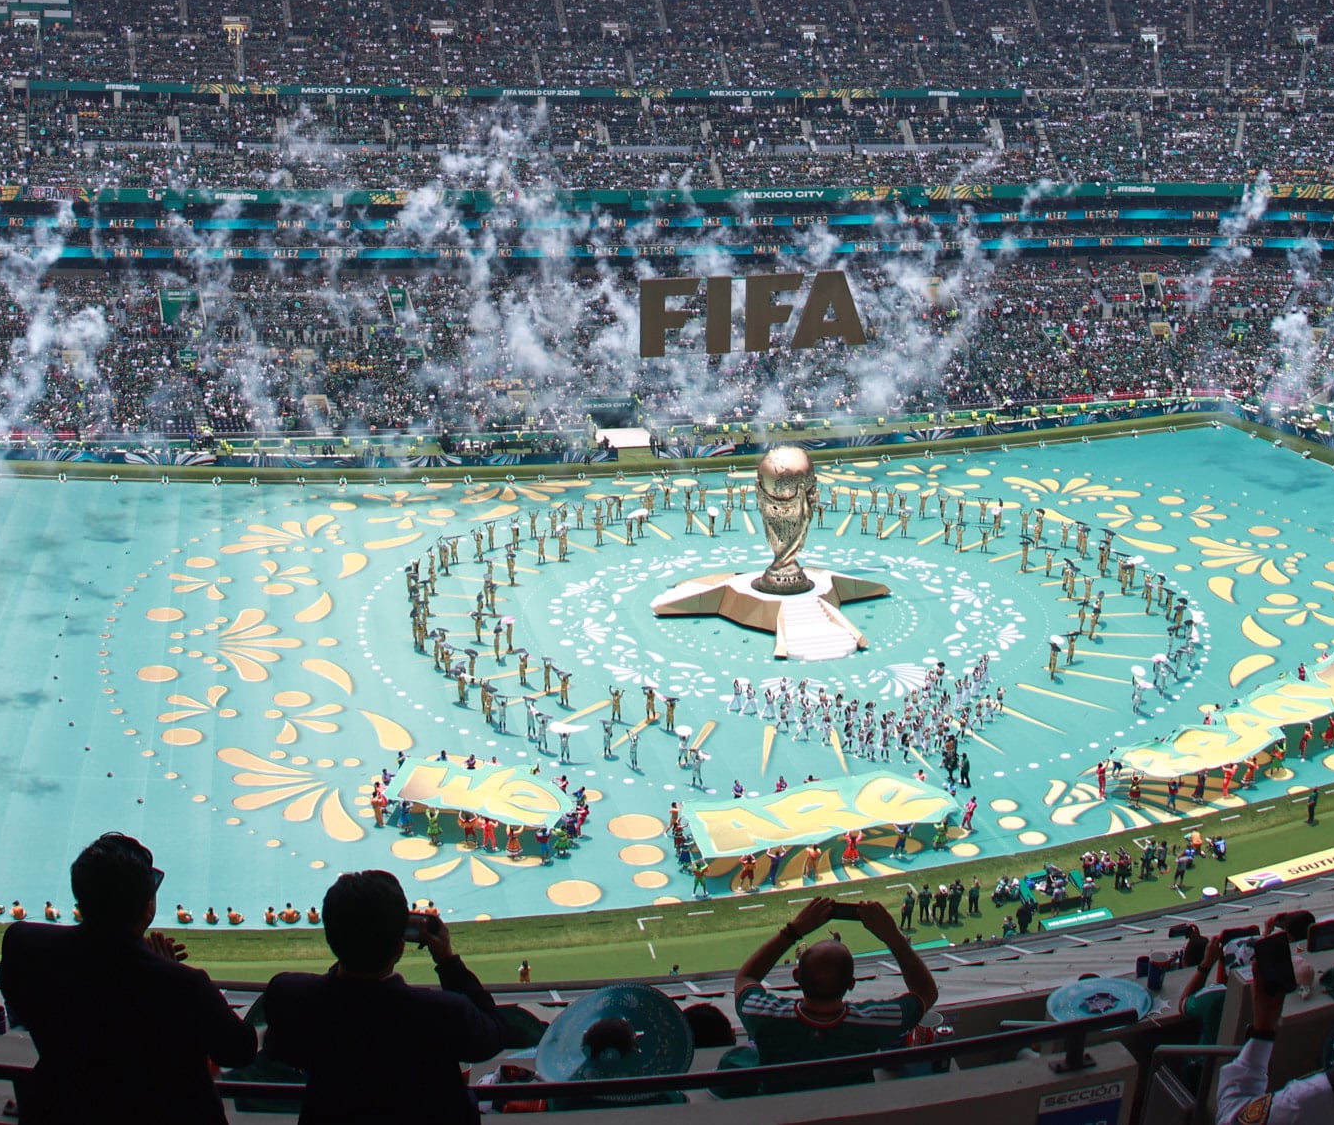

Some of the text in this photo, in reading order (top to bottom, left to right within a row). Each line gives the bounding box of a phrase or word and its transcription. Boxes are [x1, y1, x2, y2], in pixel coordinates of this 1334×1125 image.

[345, 87, 370, 95] CITY
[743, 190, 824, 199] MEXICO CITY
[1107, 209, 1118, 218] GO
[507, 219, 517, 228] GO
[817, 215, 827, 224] GO
[1252, 238, 1262, 246] GO
[345, 249, 357, 257] GO
[664, 246, 675, 254] GO
[639, 270, 867, 357] FIFA
